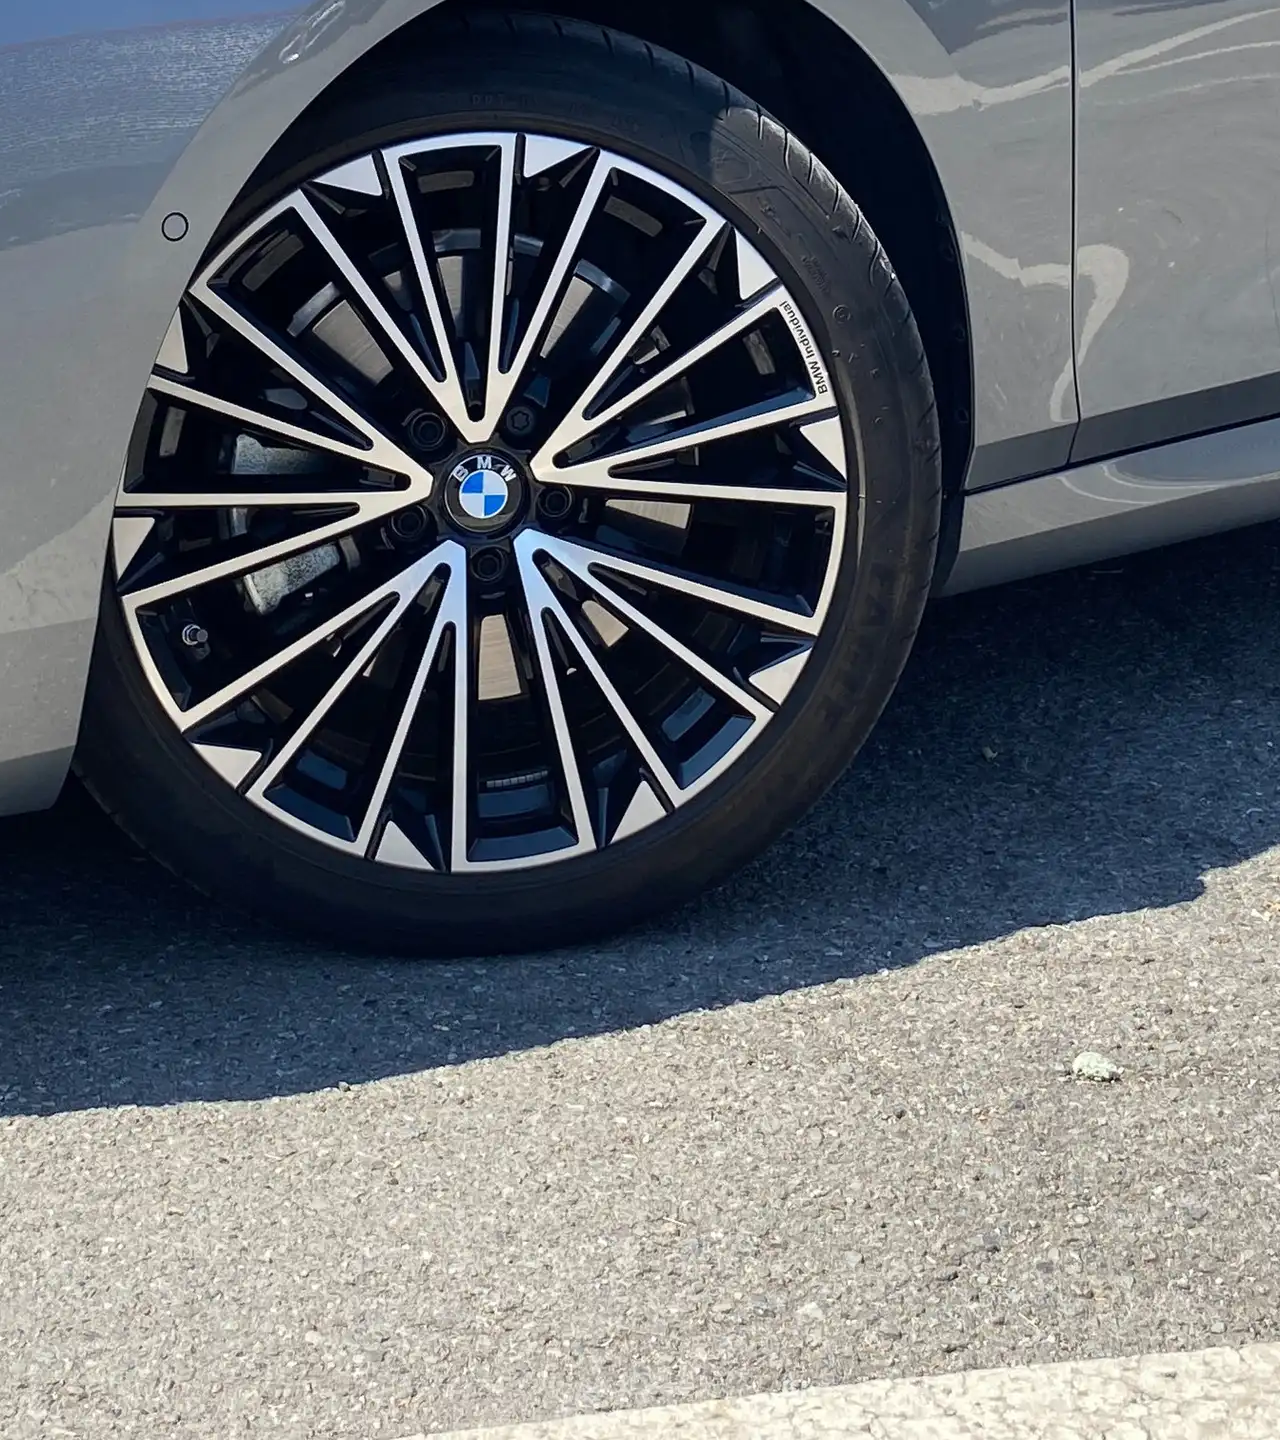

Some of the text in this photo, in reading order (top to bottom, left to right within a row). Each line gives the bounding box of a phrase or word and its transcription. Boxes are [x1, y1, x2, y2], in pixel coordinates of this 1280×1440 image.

[779, 300, 828, 395] BMW Individual
[451, 455, 518, 483] BMW
